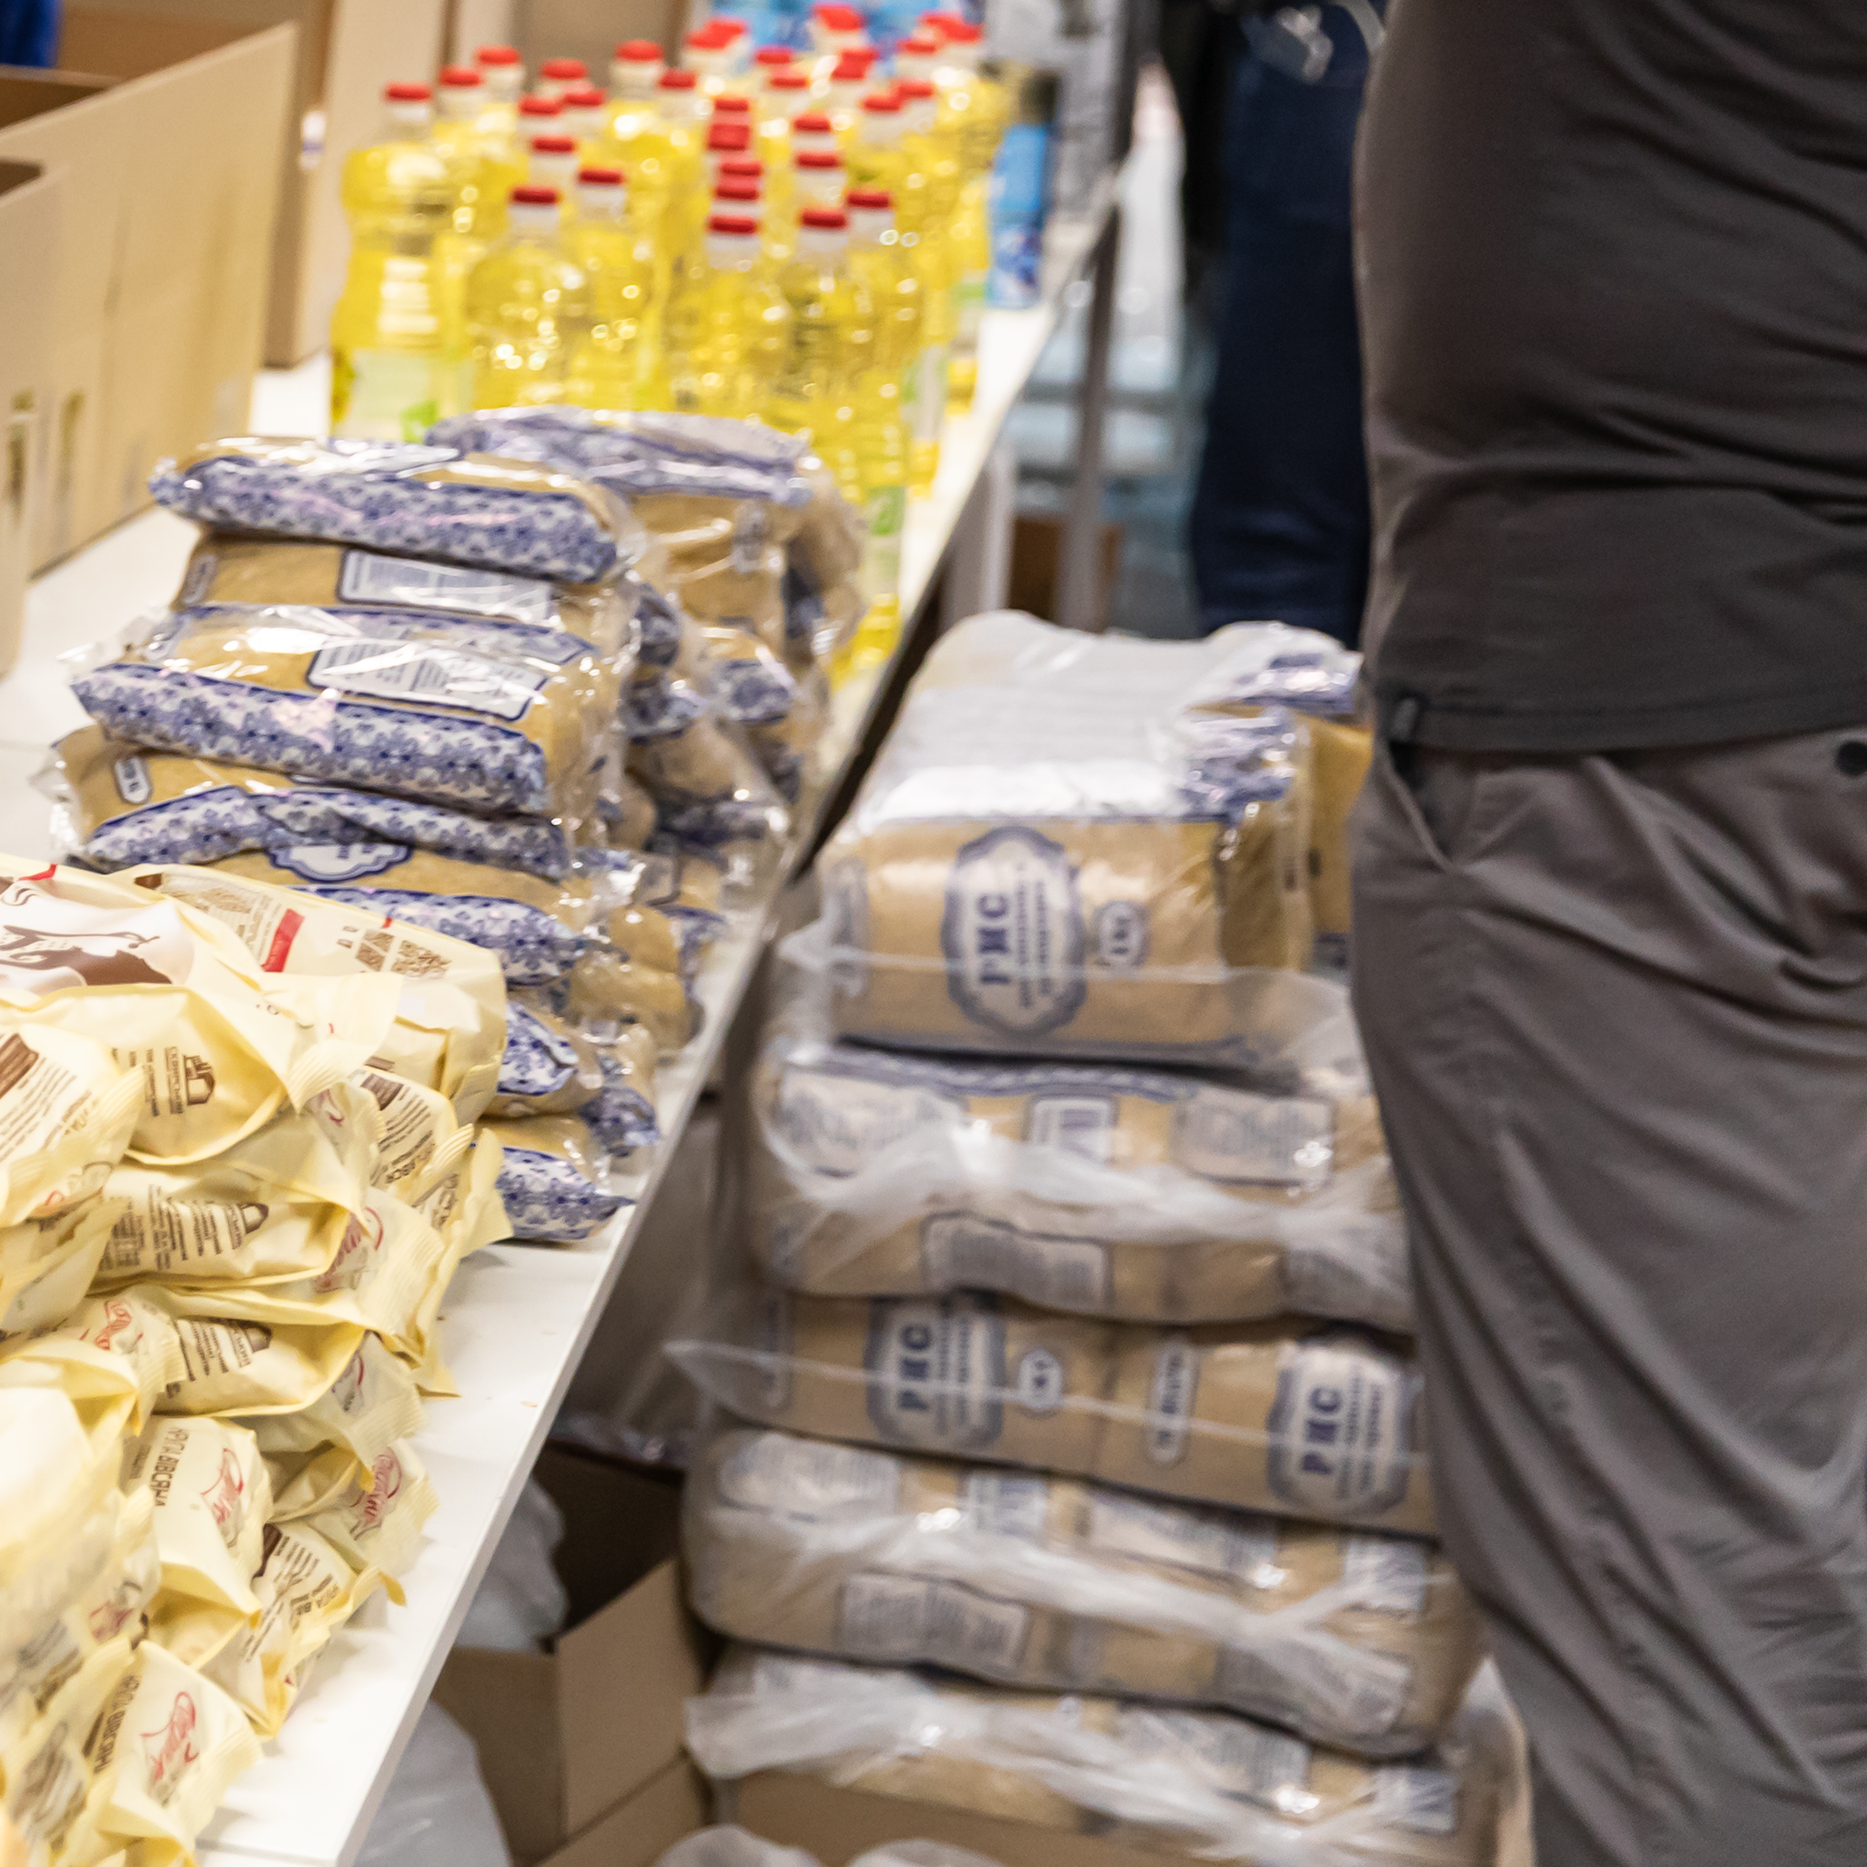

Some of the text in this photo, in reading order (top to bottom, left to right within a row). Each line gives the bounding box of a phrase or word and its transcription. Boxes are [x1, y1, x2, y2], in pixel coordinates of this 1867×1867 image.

[978, 893, 1012, 986] РИС
[898, 1324, 932, 1415] РИС
[1300, 1386, 1343, 1476] РИС
